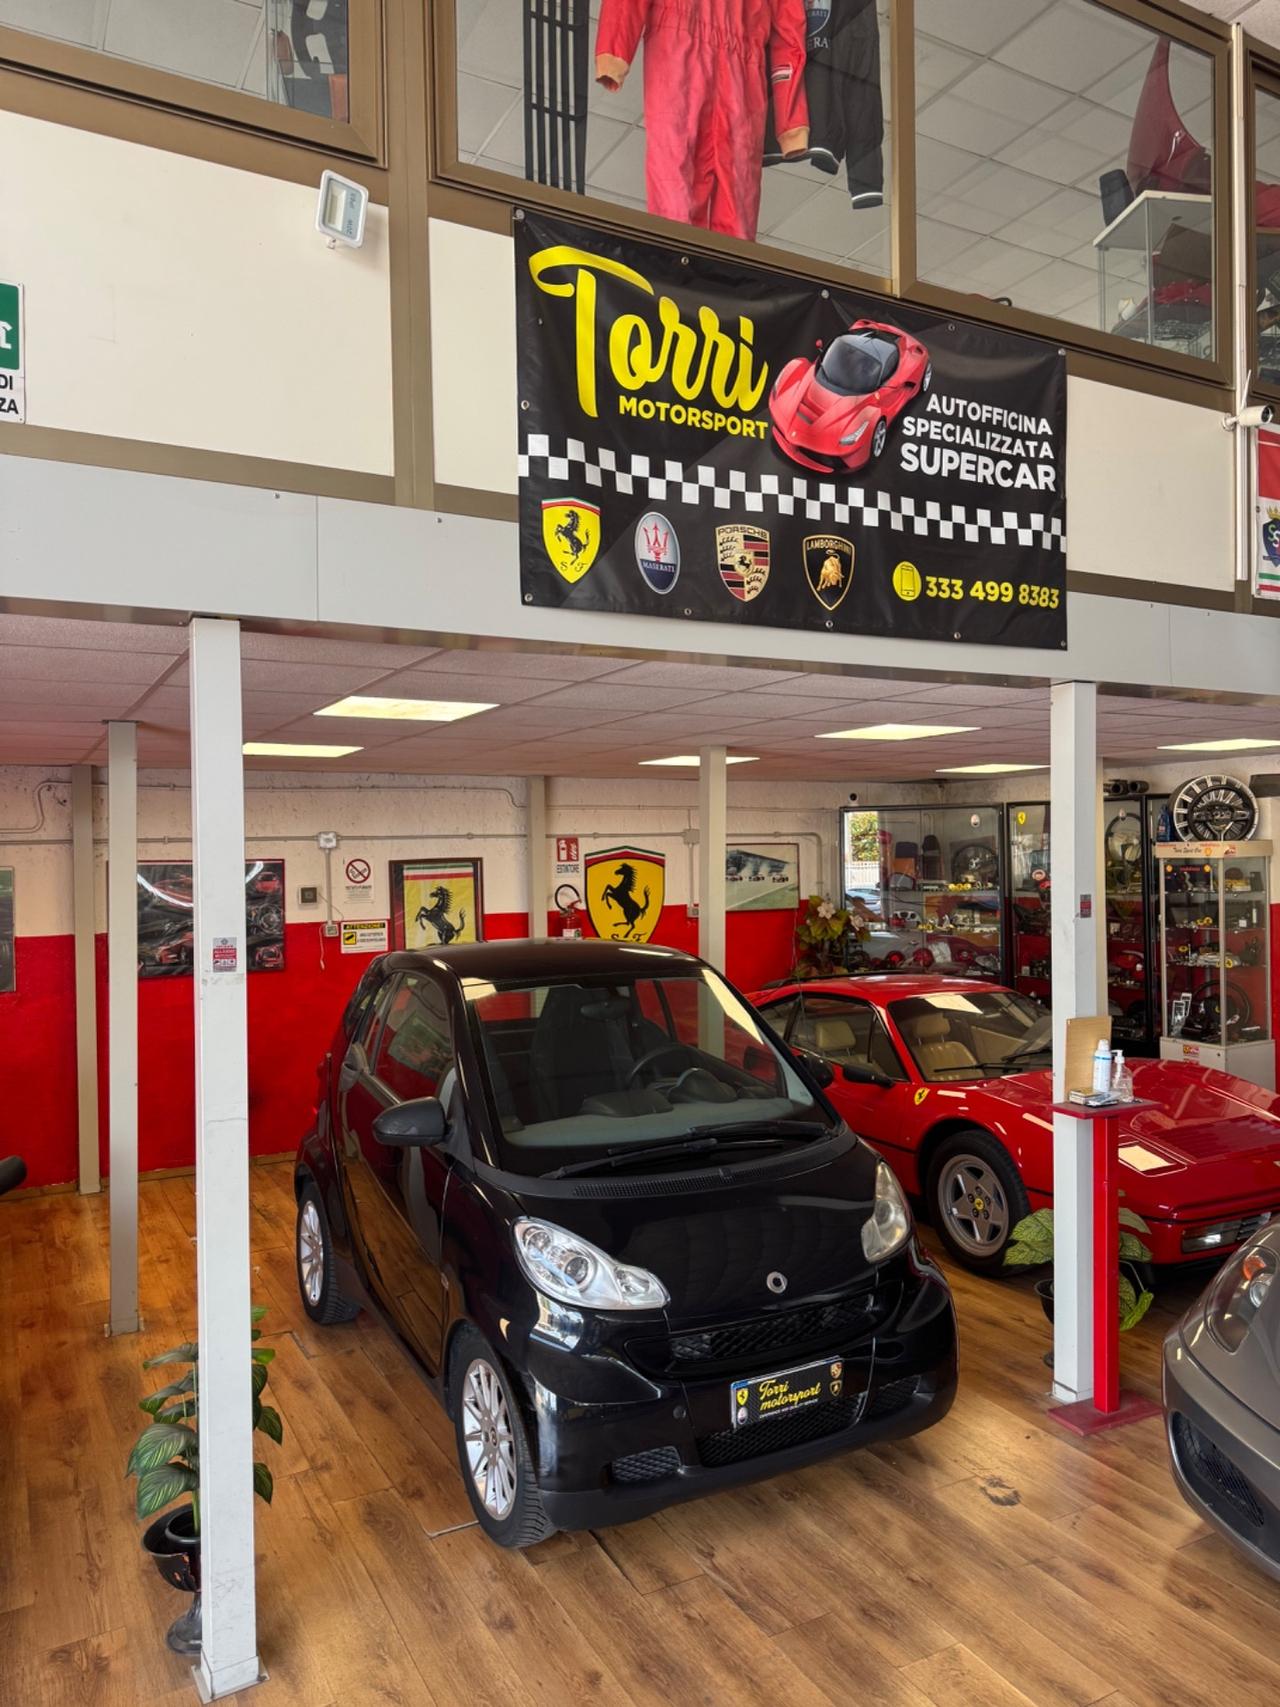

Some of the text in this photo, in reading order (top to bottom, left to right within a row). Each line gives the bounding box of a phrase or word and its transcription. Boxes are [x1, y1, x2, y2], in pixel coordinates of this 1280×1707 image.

[528, 245, 769, 418] Torri
[618, 395, 769, 440] MOTORSPORT
[926, 393, 1053, 436] AUTOFFICINA
[902, 415, 1055, 459] SPECIALIZZATA
[900, 442, 1057, 492] SUPERCAR
[717, 524, 768, 539] PORSCHE
[642, 560, 675, 573] MASERATI
[925, 575, 1060, 609] 333 499 8383
[759, 1379, 789, 1400] Torri
[760, 1382, 821, 1411] motorsport
